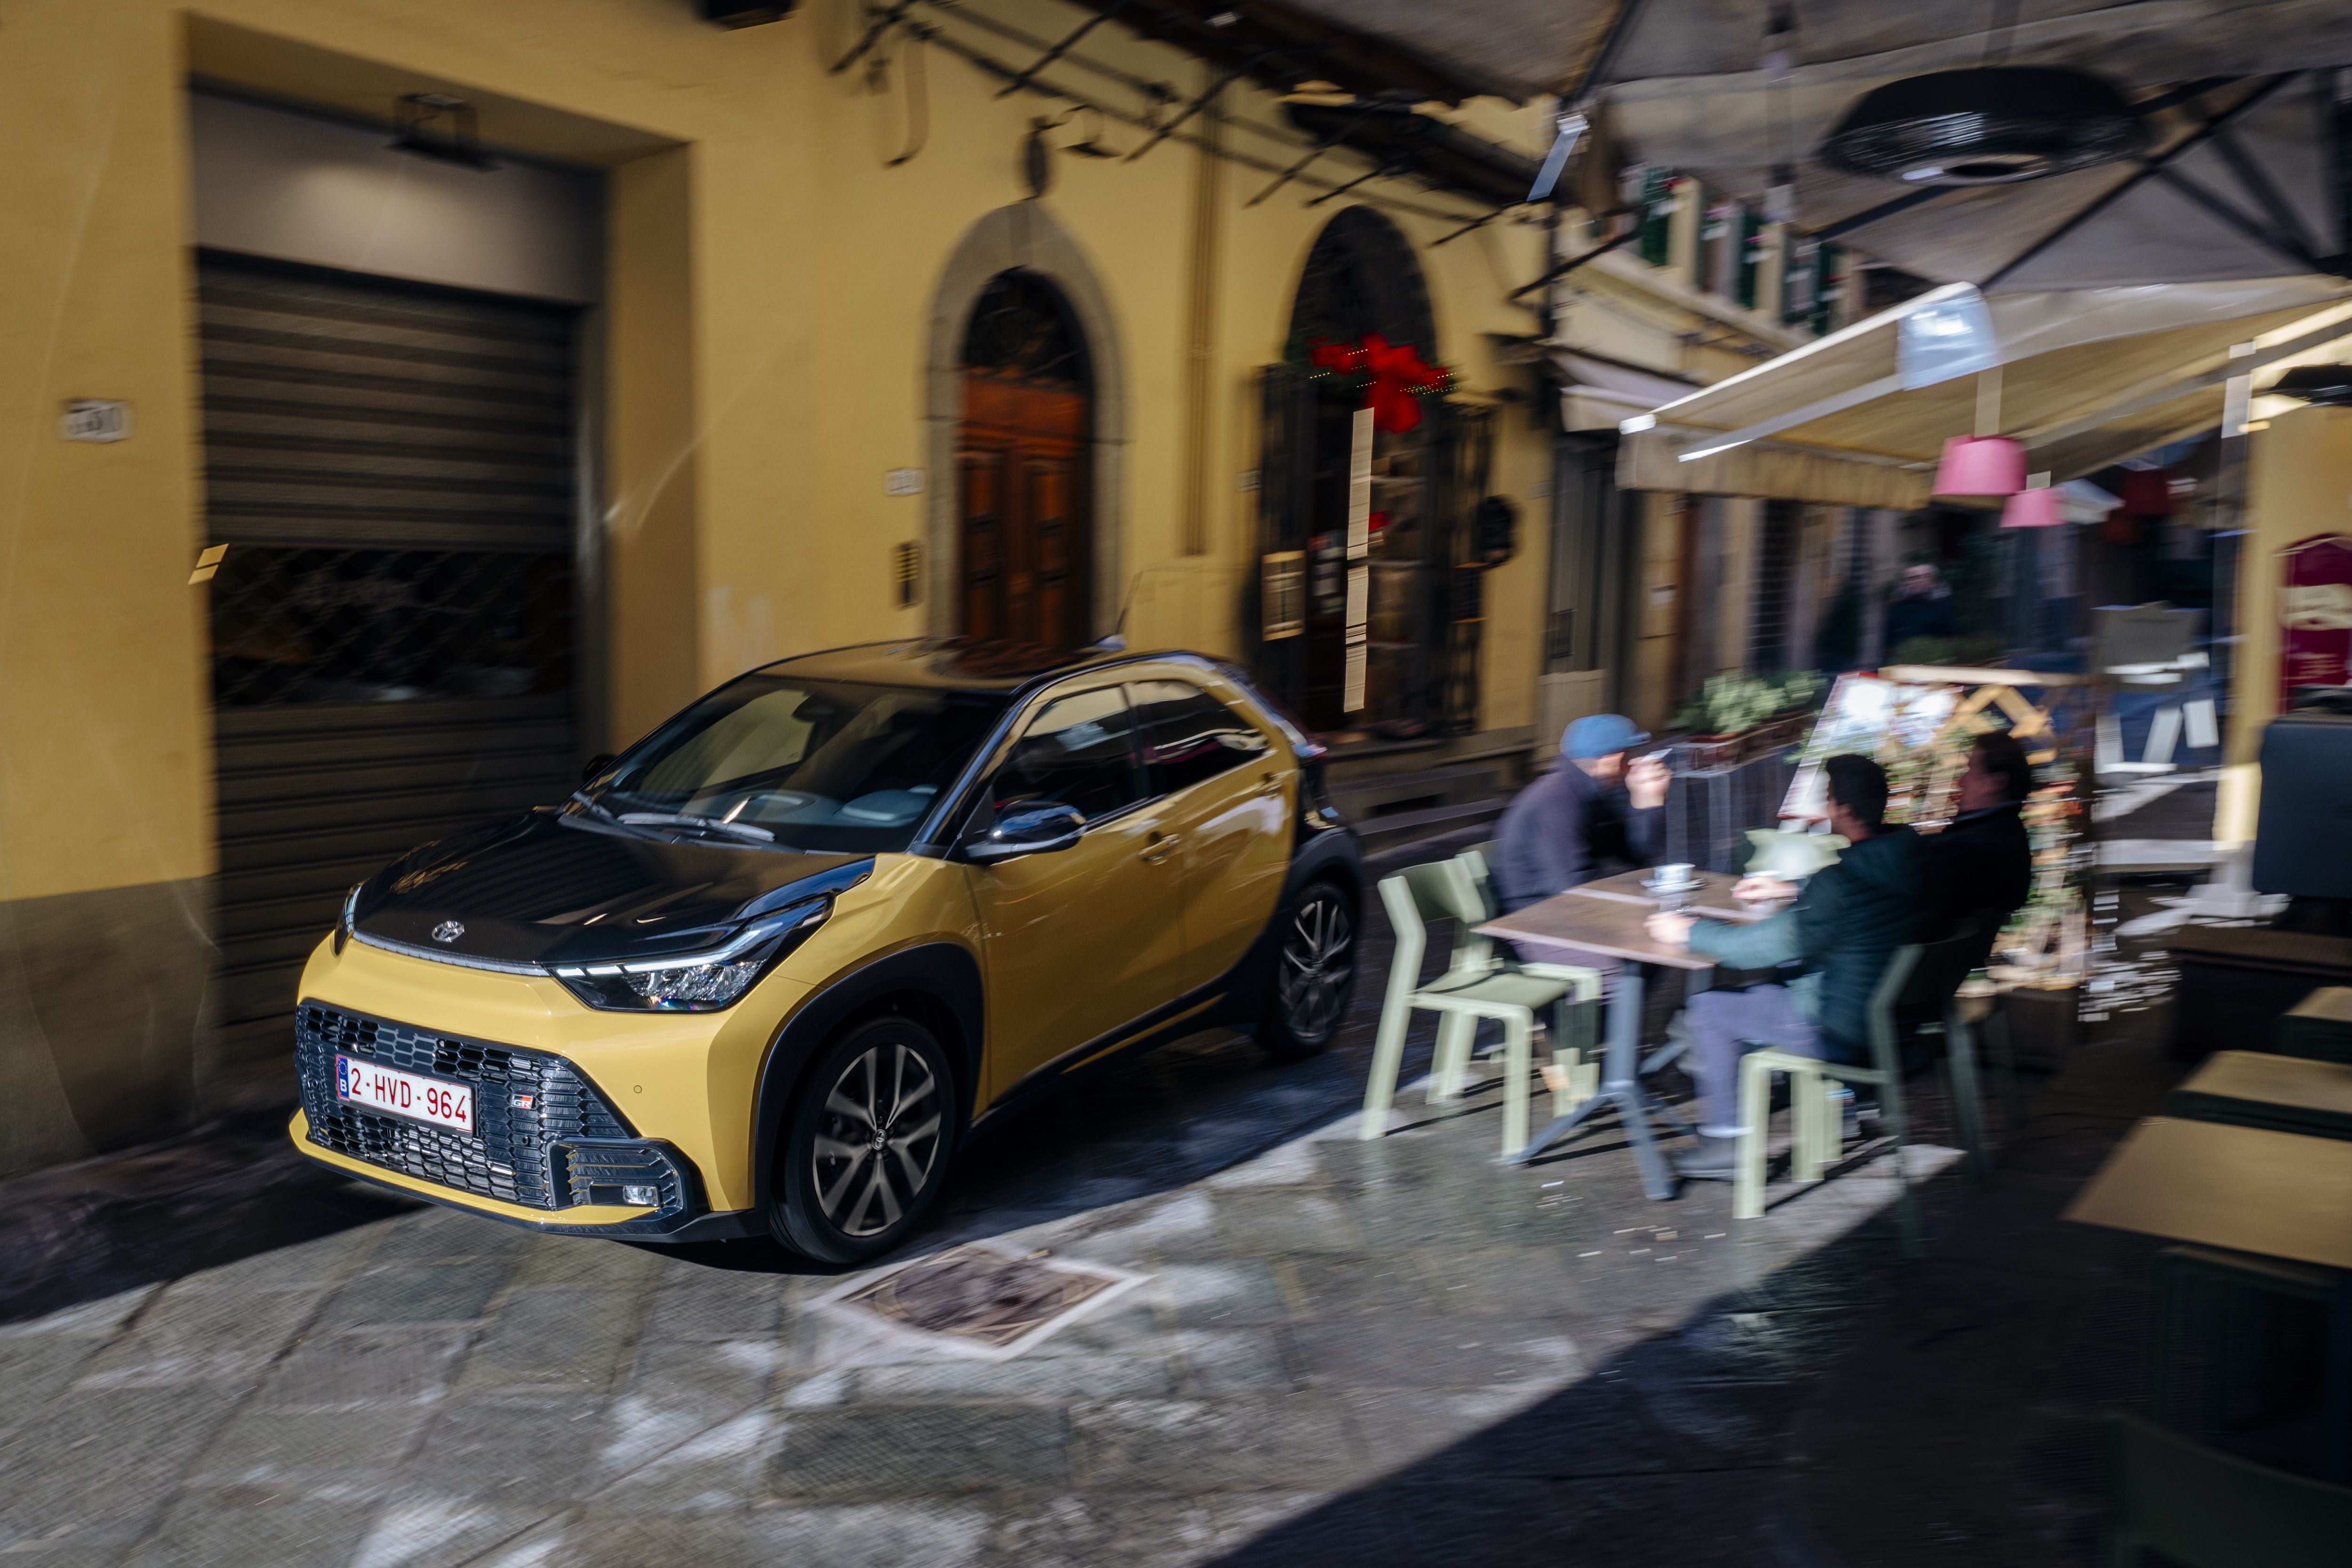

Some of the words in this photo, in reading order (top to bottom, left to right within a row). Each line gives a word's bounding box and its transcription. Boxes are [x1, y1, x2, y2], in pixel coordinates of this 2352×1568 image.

[340, 1078, 348, 1093] B
[351, 1067, 467, 1122] 2-HVD-964
[513, 1099, 532, 1108] GR
